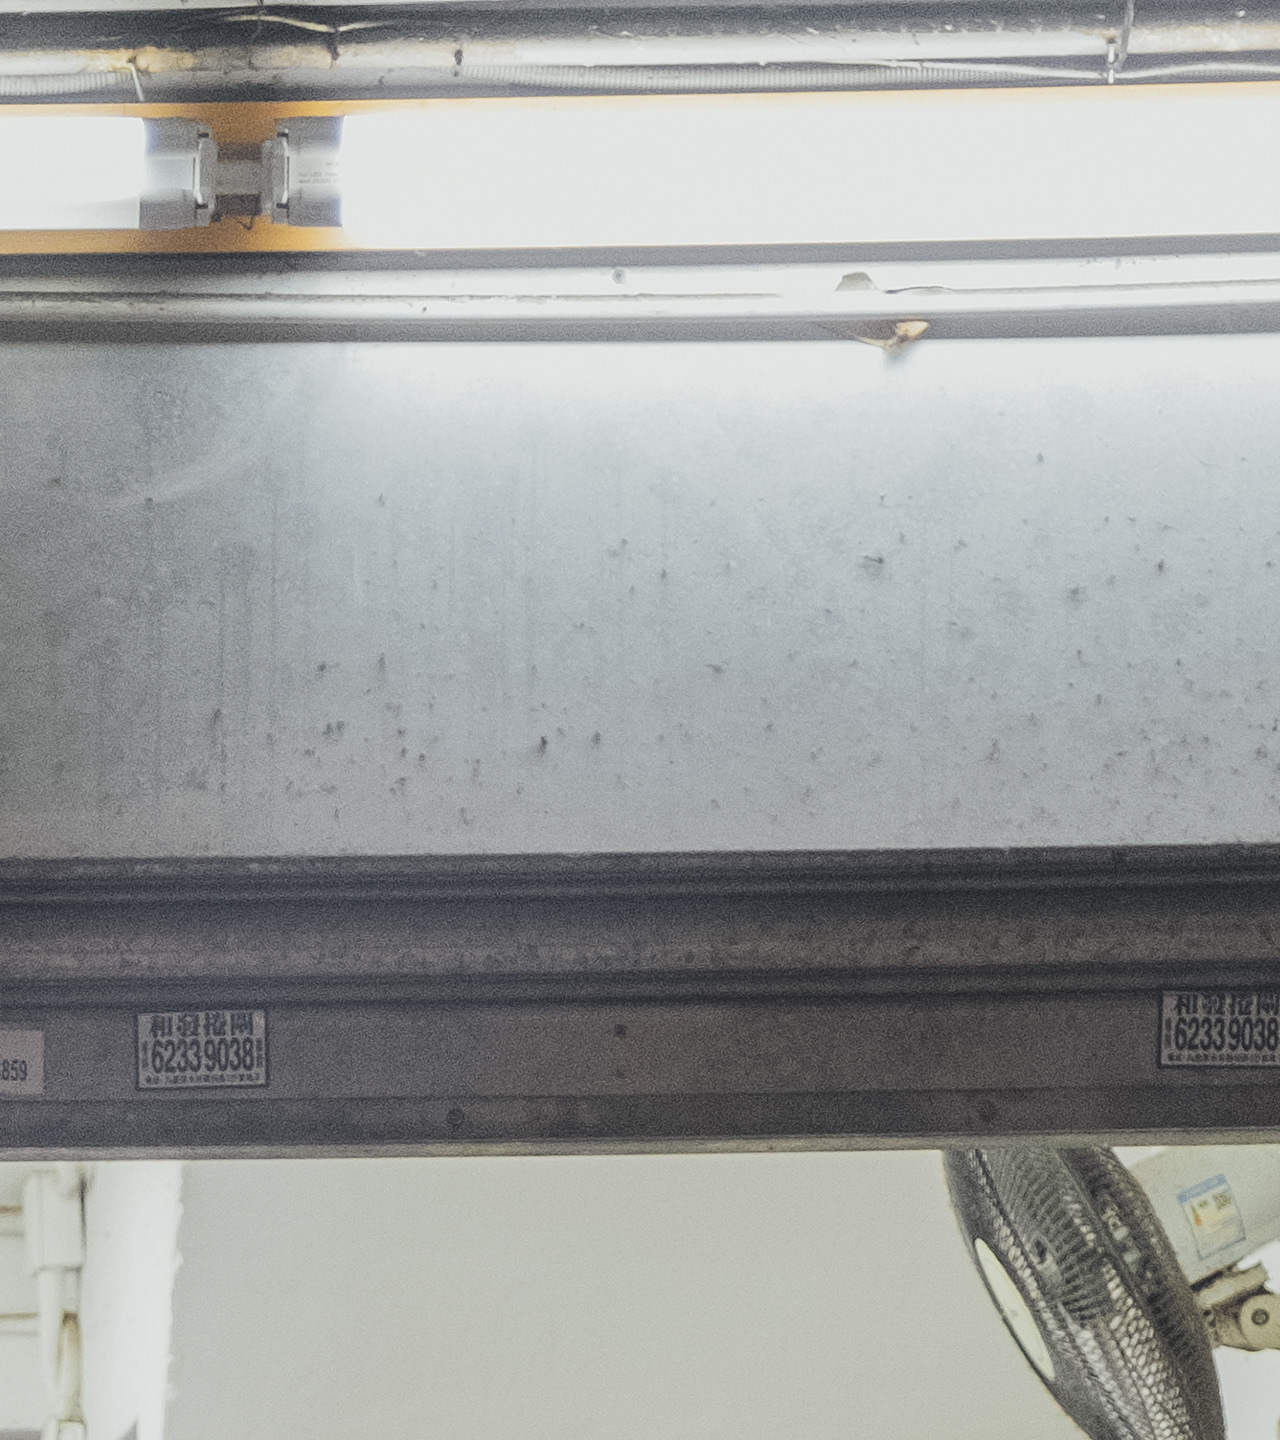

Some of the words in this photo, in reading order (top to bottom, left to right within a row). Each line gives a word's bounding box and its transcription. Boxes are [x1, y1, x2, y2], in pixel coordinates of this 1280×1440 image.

[1175, 1016, 1225, 1051] 6233
[1228, 1016, 1279, 1051] 9038
[152, 1038, 201, 1073] 6233
[204, 1037, 254, 1071] 9038
